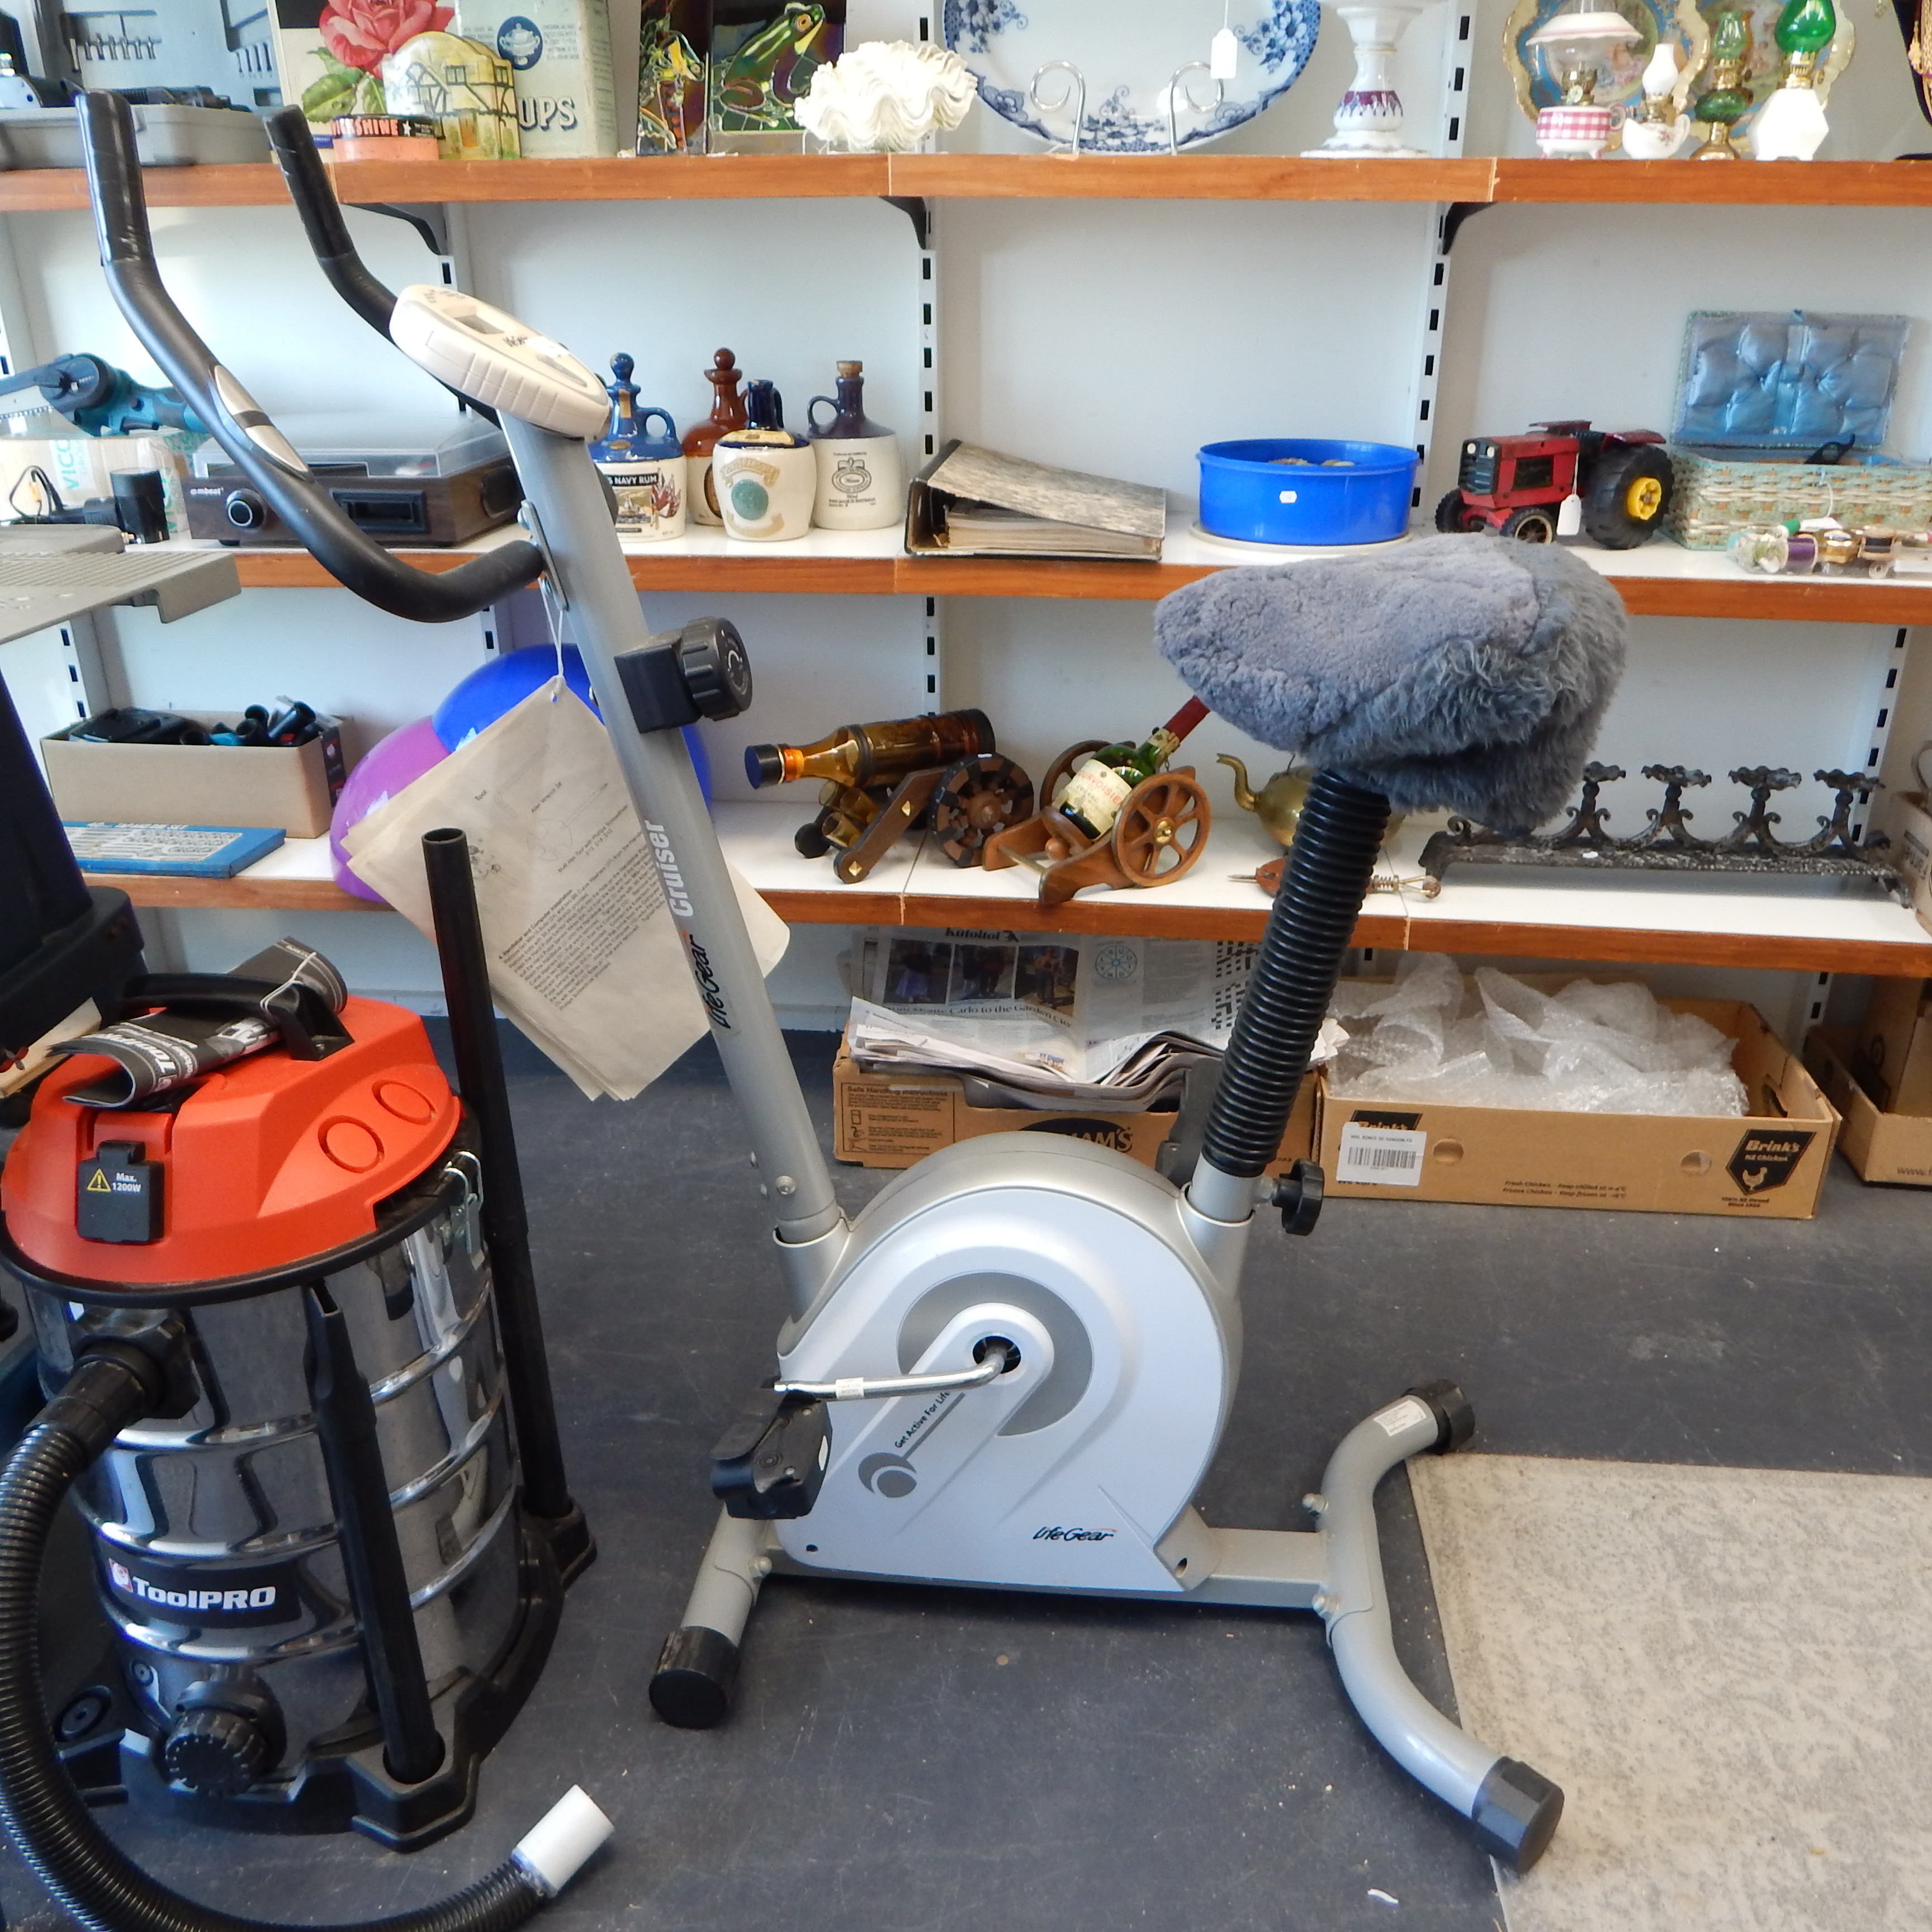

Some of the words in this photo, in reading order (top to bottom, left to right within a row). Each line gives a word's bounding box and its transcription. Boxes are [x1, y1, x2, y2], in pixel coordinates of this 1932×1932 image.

[615, 476, 637, 485] NAVY
[639, 475, 657, 484] RUM
[645, 819, 694, 917] Cruiser
[112, 1182, 141, 1192] 1200W
[116, 1172, 137, 1181] Max.
[894, 1436, 910, 1448] Get
[906, 1415, 928, 1438] Active
[924, 1404, 938, 1416] For
[132, 1575, 276, 1610] ToolPRO
